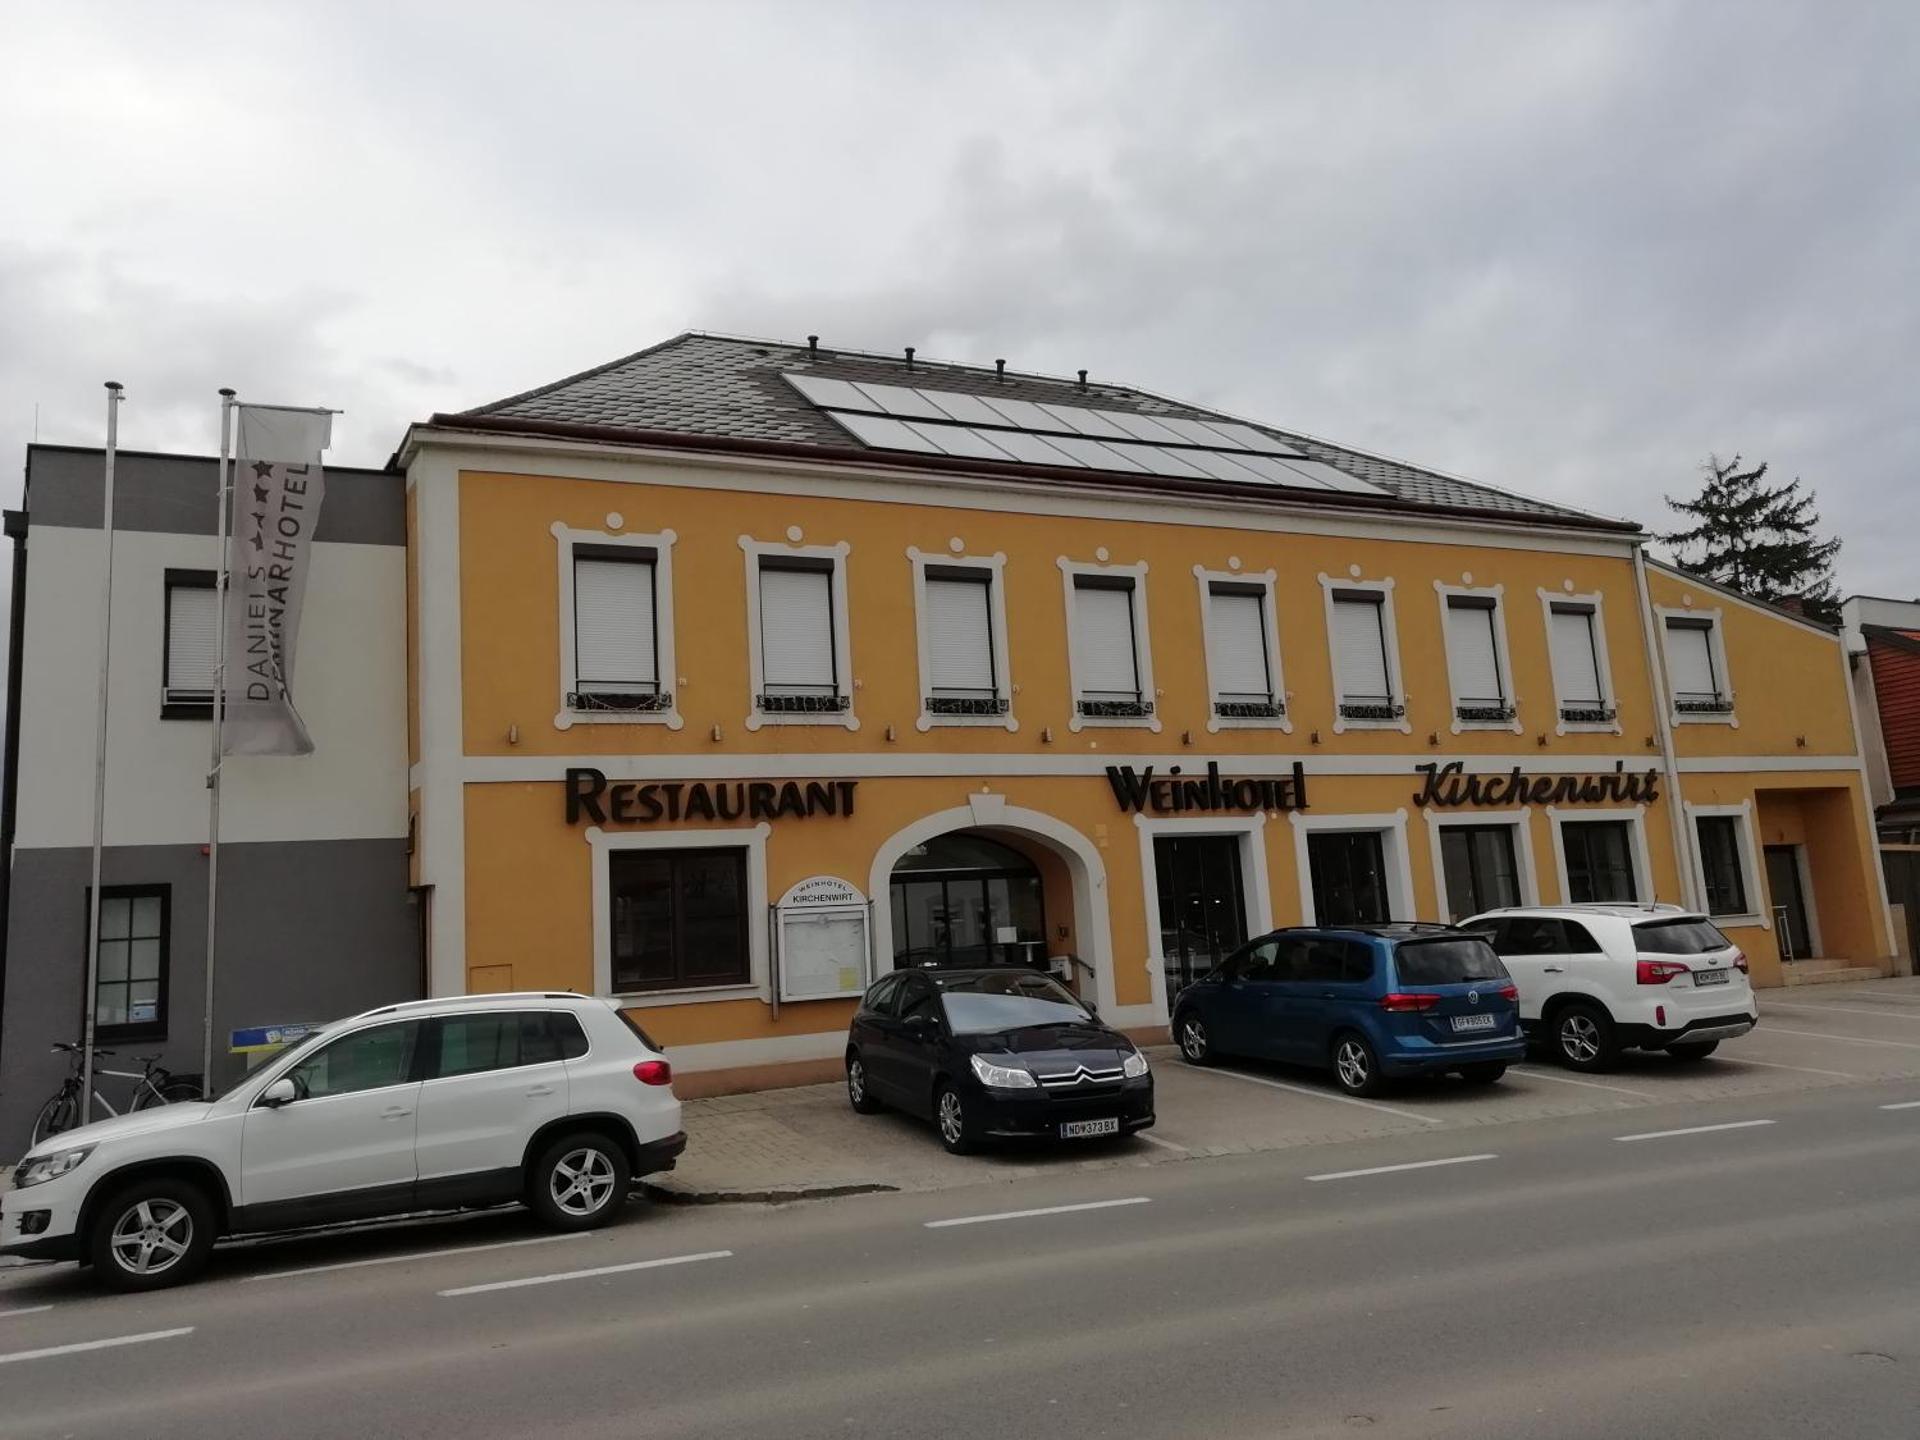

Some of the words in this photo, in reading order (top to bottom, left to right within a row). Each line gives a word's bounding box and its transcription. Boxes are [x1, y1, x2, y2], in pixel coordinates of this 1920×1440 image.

[566, 768, 859, 825] RESTAURANT
[1413, 760, 1659, 807] Kirchenwirt
[793, 893, 853, 904] KIRCHENWIRT
[799, 880, 847, 892] WEINHOTEL
